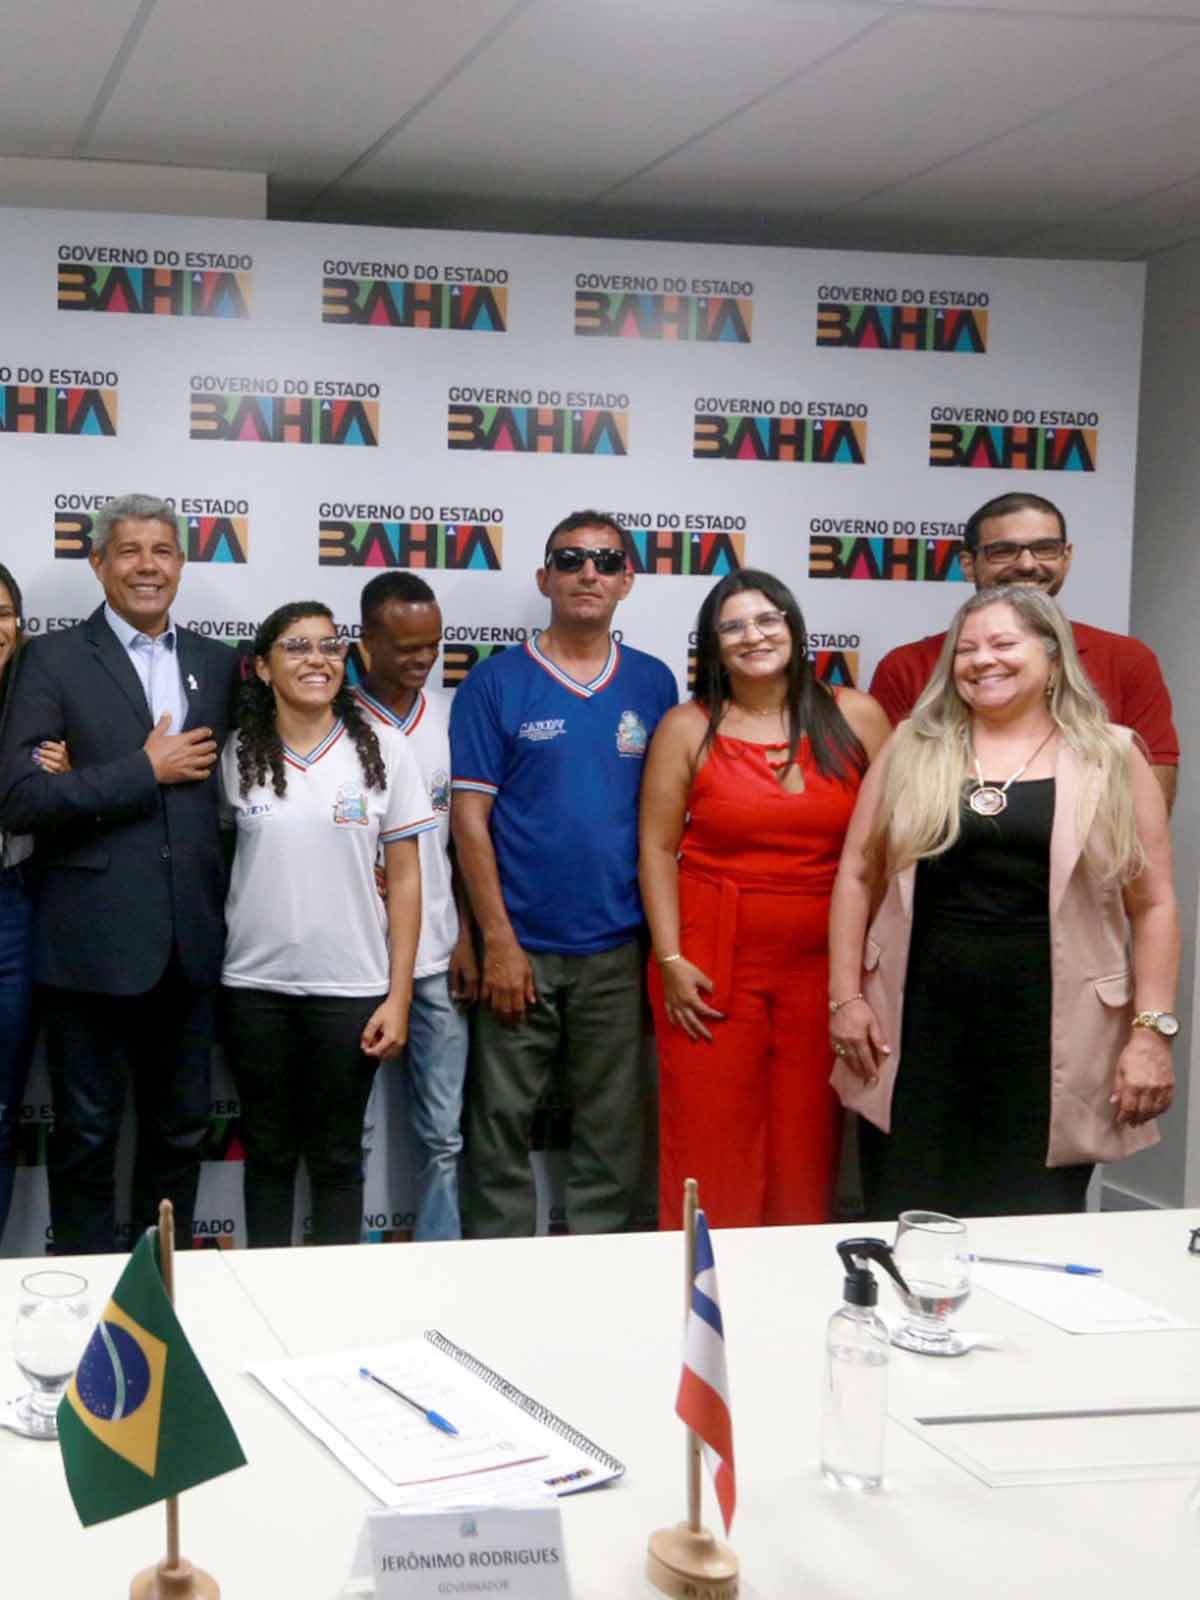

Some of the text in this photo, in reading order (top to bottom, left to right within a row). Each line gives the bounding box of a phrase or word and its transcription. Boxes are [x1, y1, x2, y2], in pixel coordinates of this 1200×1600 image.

[58, 245, 253, 270] GOVERNO DO ESTADO
[323, 260, 509, 284] GOVERNO DO ESTADO
[58, 263, 253, 318] BAHIA
[575, 273, 754, 296] GOVERNO DO ESTADO
[818, 285, 990, 307] GOVERNO DO ESTADO
[323, 280, 509, 332] BAHIA
[575, 293, 754, 343] BAHIA
[818, 306, 990, 354] BAHIA
[18, 368, 43, 383] DO
[50, 369, 119, 386] ESTADO
[190, 375, 381, 398] GOVERNO DO ESTADO
[449, 387, 630, 409] GOVERNO DO ESTADO
[694, 397, 868, 418] GOVERNO DO ESTADO
[190, 396, 381, 447] BAHIA
[930, 406, 1100, 426] GOVERNO DO ESTADO
[449, 406, 630, 456] BAHIA
[694, 417, 868, 465] BAHIA
[929, 424, 1099, 471] BAHIA
[181, 498, 249, 515] ESTADO
[319, 503, 504, 523] GOVERNO DO ESTADO
[656, 514, 680, 529] DO
[685, 515, 746, 531] ESTADO
[810, 518, 968, 537] GOVERNO DO ESTAD
[318, 521, 504, 570] BAHIA
[188, 620, 260, 637] GOVERN
[444, 626, 527, 642] GOVERNO
[808, 633, 860, 648] STADO
[193, 1219, 234, 1234] TADO
[381, 1548, 559, 1572] JERÔNIMO RODRIGUES
